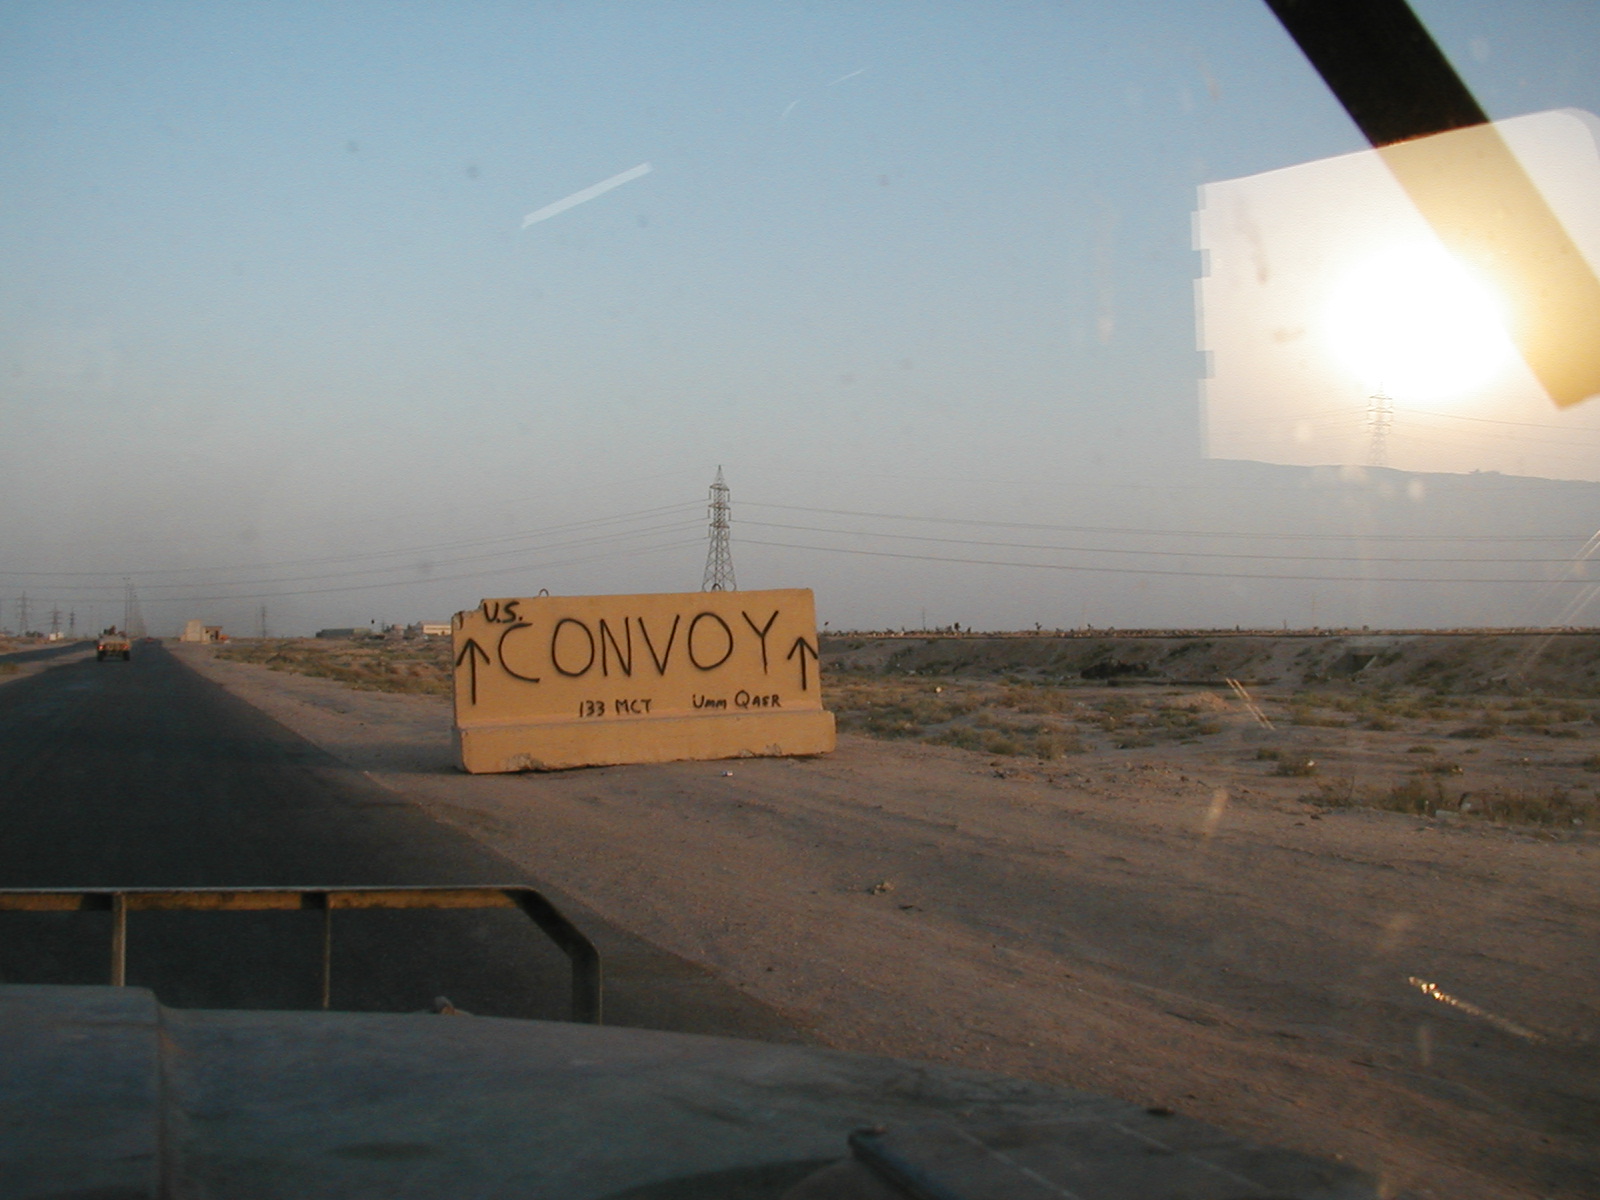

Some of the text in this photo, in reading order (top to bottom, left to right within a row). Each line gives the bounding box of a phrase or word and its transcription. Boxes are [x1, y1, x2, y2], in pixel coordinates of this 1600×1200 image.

[483, 601, 523, 624] U.S.
[497, 611, 779, 683] CONVOY
[579, 699, 606, 718] 133
[615, 698, 652, 715] MCT
